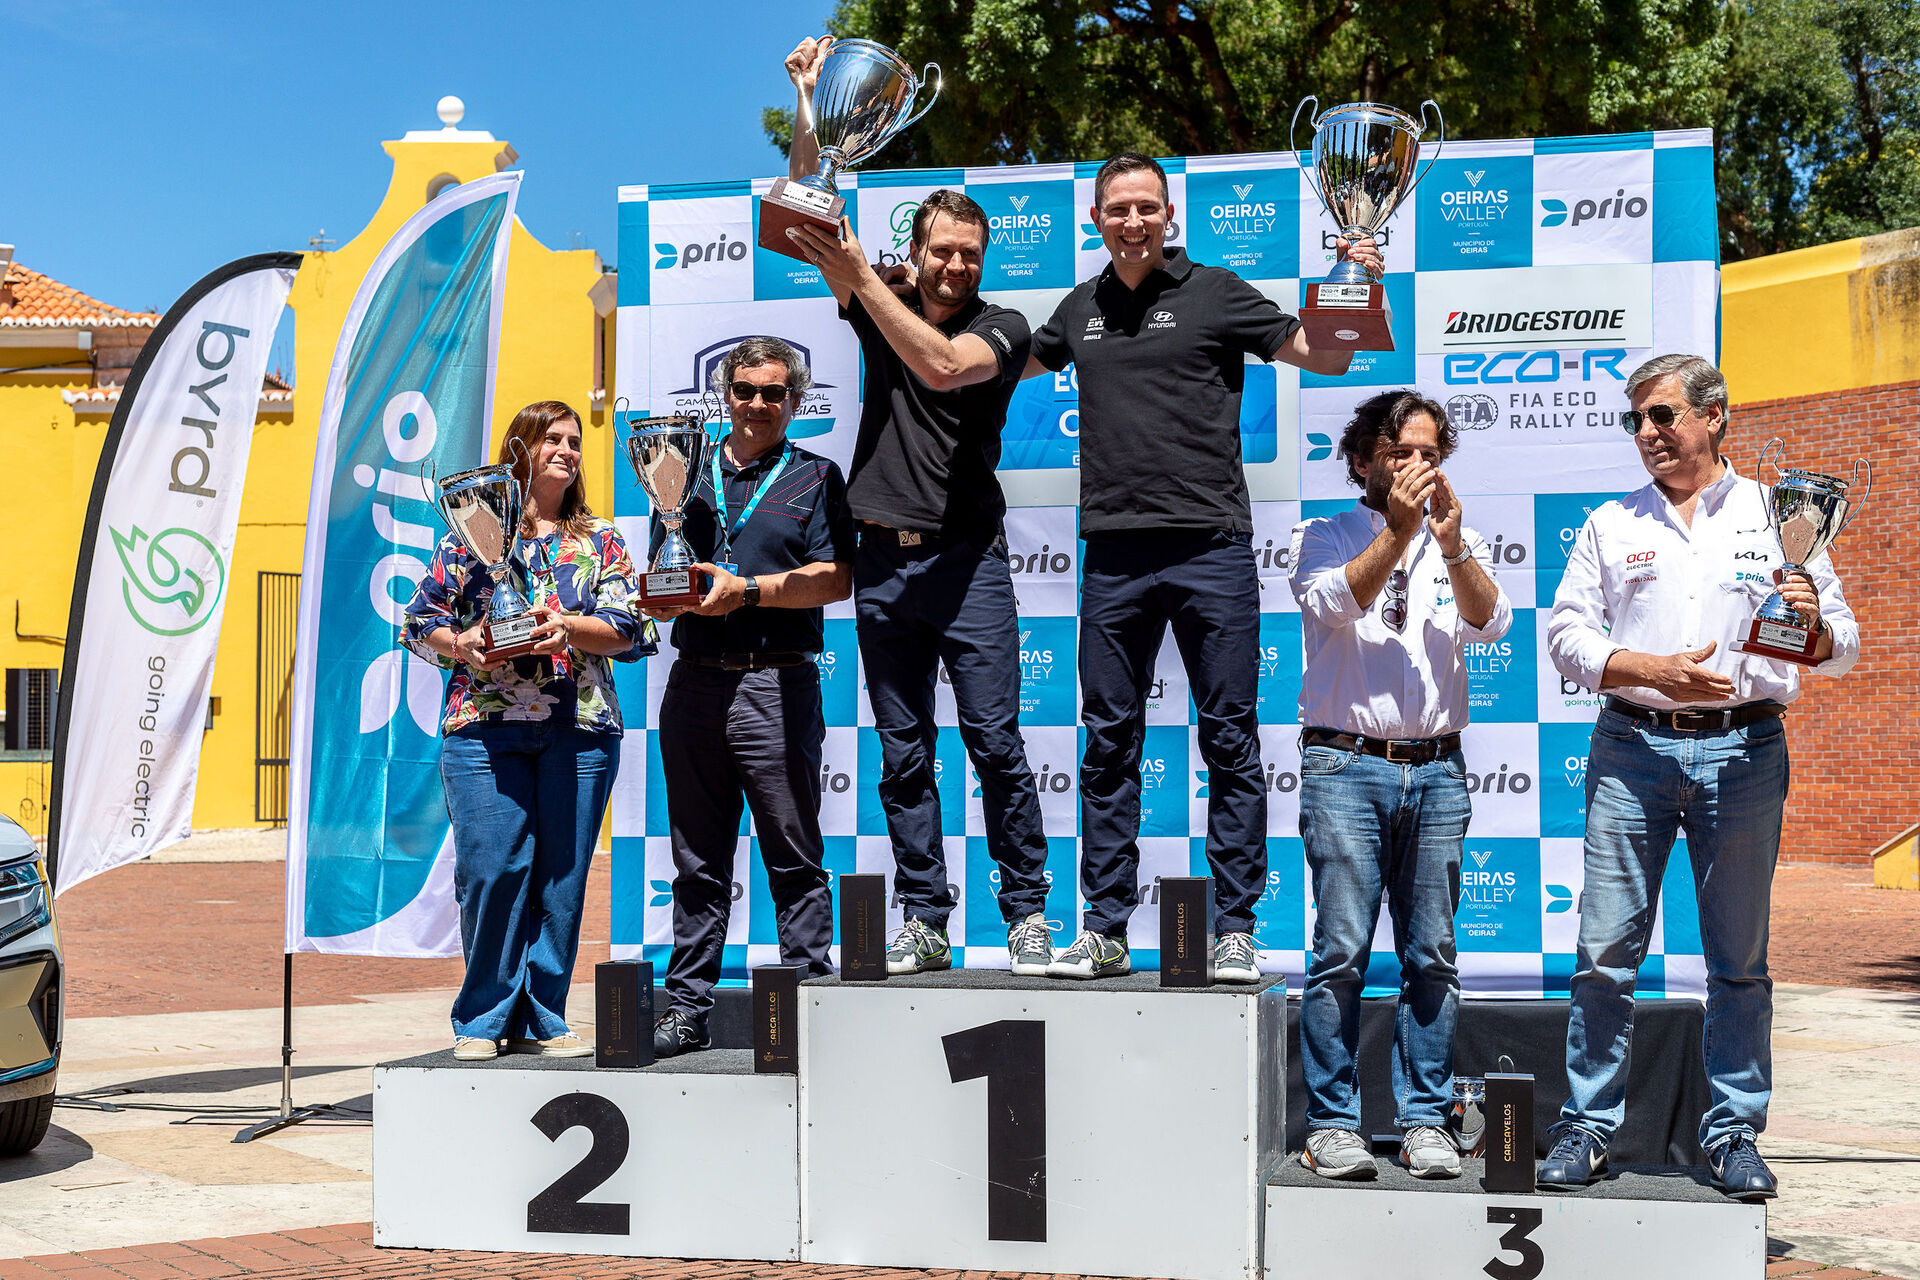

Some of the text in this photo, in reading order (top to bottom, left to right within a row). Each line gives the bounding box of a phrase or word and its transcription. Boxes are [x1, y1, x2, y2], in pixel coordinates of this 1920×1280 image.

[1440, 189, 1509, 206] OEIRAS
[1210, 202, 1276, 219] OEIRAS
[1440, 205, 1509, 221] VALLEY
[1571, 188, 1648, 227] prio
[988, 213, 1052, 230] OEIRAS
[1210, 218, 1276, 234] VALLEY
[989, 228, 1052, 245] VALLEY
[1322, 226, 1389, 250] bd
[681, 233, 747, 269] prio
[1460, 246, 1488, 254] OEIRAS
[1444, 309, 1626, 334] BRIDGESTONE
[1348, 364, 1370, 372] EIRAS
[1510, 391, 1596, 408] FIA ECO
[168, 320, 250, 498] byrd
[1510, 412, 1576, 429] RALLY
[1626, 550, 1656, 564] acp
[1744, 572, 1765, 583] prio
[1019, 649, 1053, 663] RAS
[1464, 642, 1512, 657] EIRAS
[1564, 698, 1592, 708] going
[131, 655, 166, 838] going electric
[821, 764, 851, 793] io
[1266, 763, 1298, 793] io
[1460, 871, 1516, 886] EIRAS
[1459, 888, 1516, 903] ALLEY
[1177, 902, 1185, 959] CARCAVELOS
[1460, 921, 1494, 930] MUNICÍPIO
[1468, 929, 1497, 937] OEIRAS
[769, 991, 777, 1046] CARCAVELOS
[941, 1019, 1048, 1242] 1
[1503, 1103, 1512, 1162] CARCAVELOS
[526, 1092, 631, 1236] 2
[1482, 1206, 1544, 1280] 3
